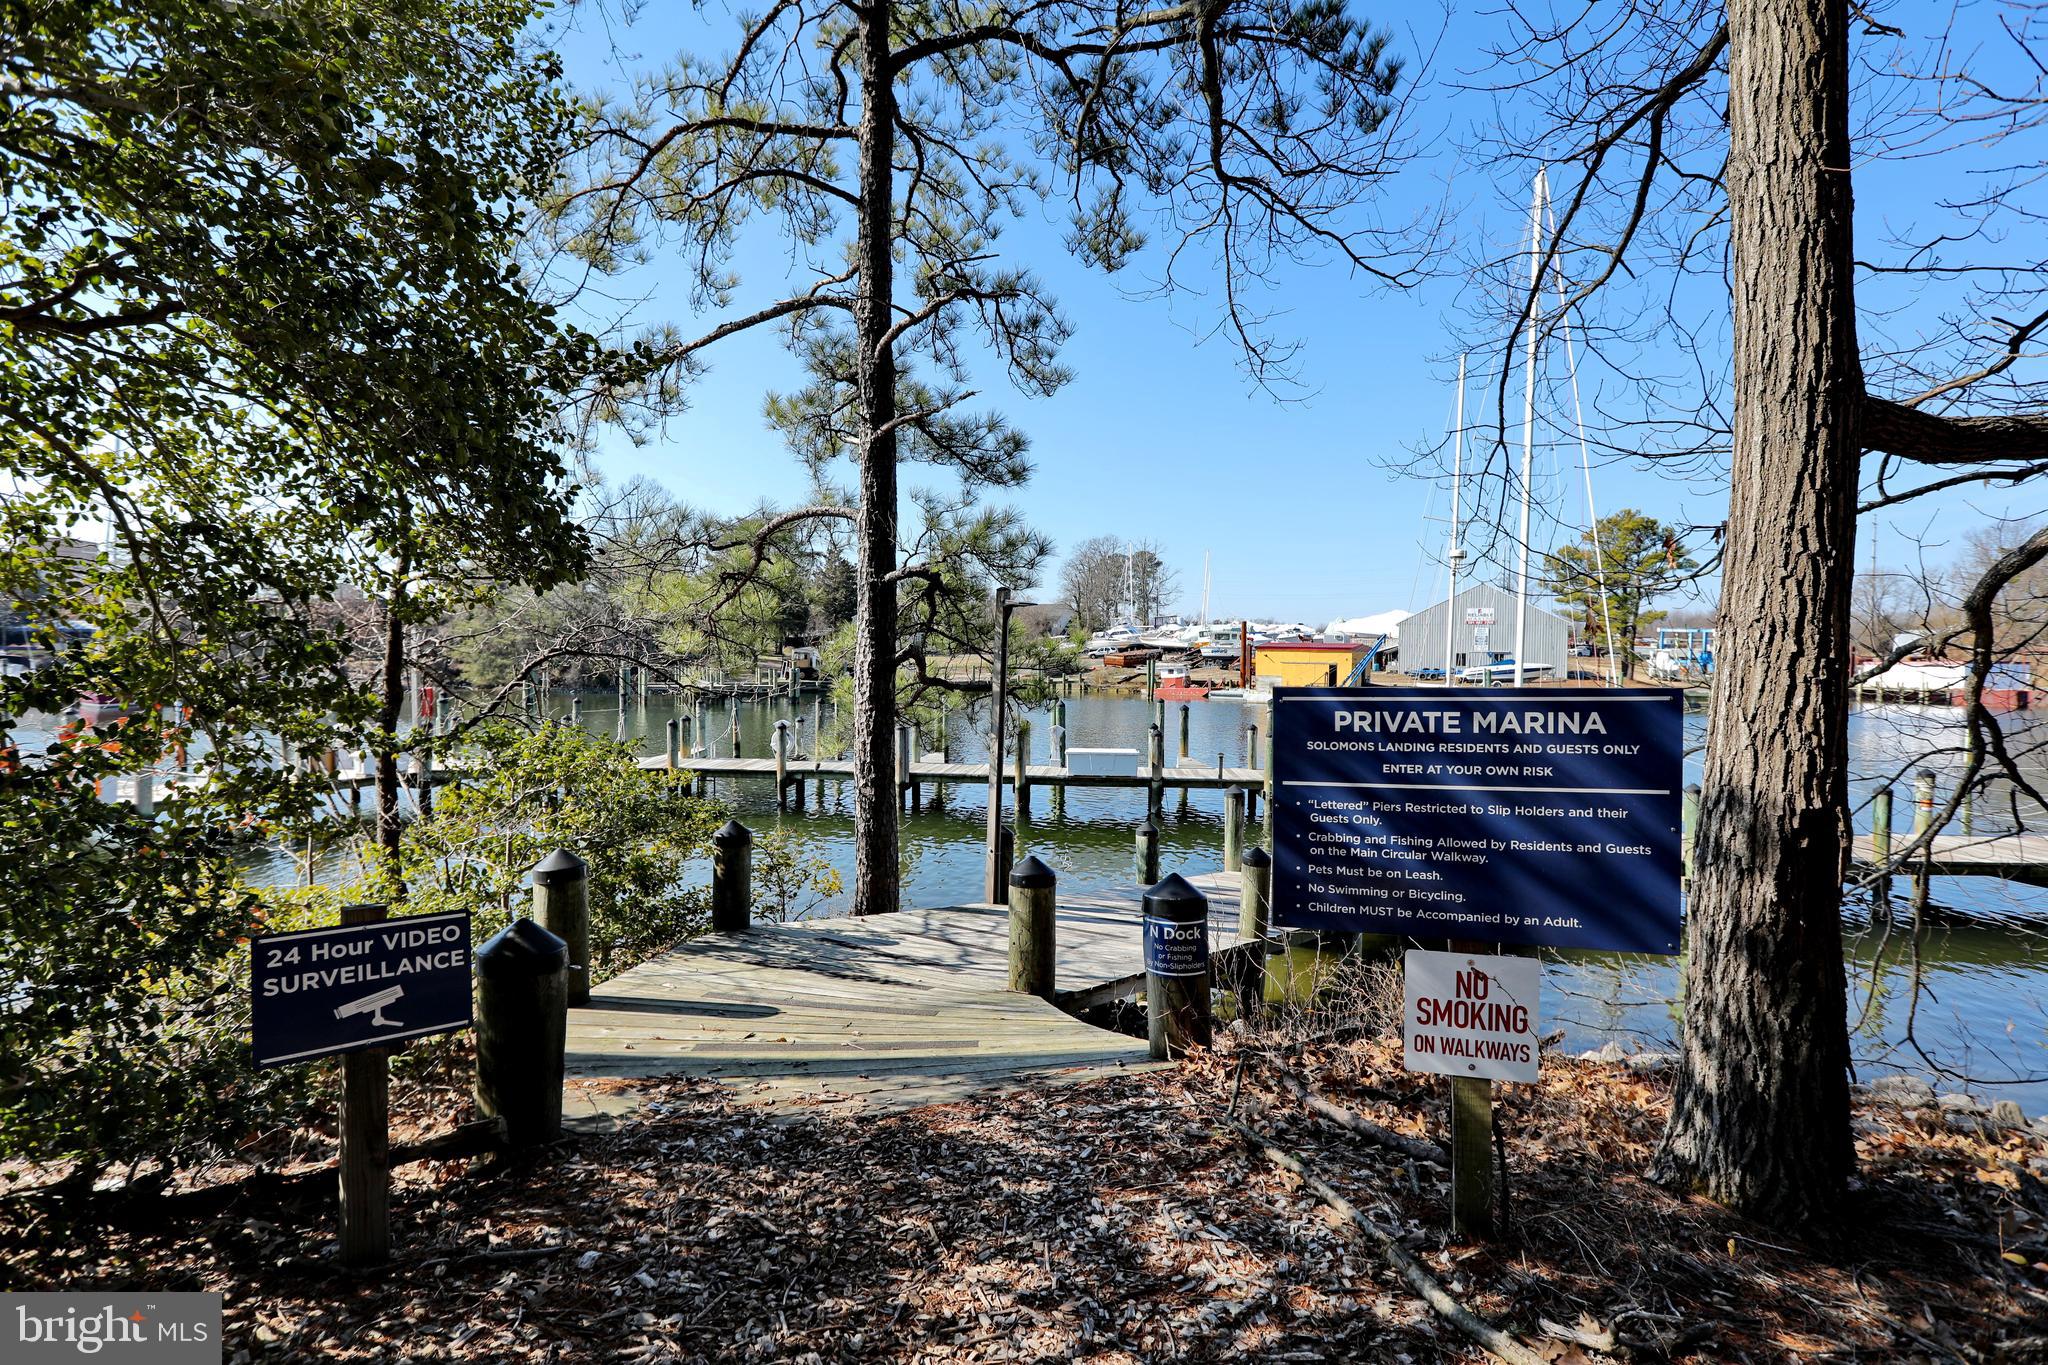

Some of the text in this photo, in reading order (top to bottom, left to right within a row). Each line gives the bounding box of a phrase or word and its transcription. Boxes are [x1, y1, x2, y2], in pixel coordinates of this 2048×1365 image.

[1334, 710, 1607, 734] PRIVATE MARINA
[1307, 741, 1640, 755] SOLOMONS LANDING RESIDENTS AND GUESTS ONLY
[1383, 764, 1553, 776] ENTER AT YOUR OWN RISK
[1310, 813, 1382, 826] Guests Only.
[1373, 801, 1401, 812] Piers
[1405, 803, 1467, 814] Restricted
[1471, 805, 1484, 815] to
[1488, 804, 1510, 816] Slip
[1515, 806, 1564, 817] Holders
[1568, 808, 1593, 818] and
[1597, 808, 1628, 819] their
[1308, 832, 1651, 855] Crabbing and Fishing Allowed by Residents and Guests
[1310, 847, 1488, 864] on the Main Circular Walkway.
[1308, 864, 1443, 881] Pets Must be on Leash.
[1308, 884, 1466, 902] No Swimming or Bicycling.
[1308, 902, 1582, 928] Children MUST be Accompanied by an Adult.
[1150, 925, 1200, 940] N Dock
[266, 925, 461, 969] 24 Hour VIDEO
[263, 949, 465, 997] SURVEILLANCE
[1456, 970, 1489, 1000] NO
[1416, 998, 1528, 1034] SMOKING
[1414, 1034, 1530, 1063] ON WALKWAYS
